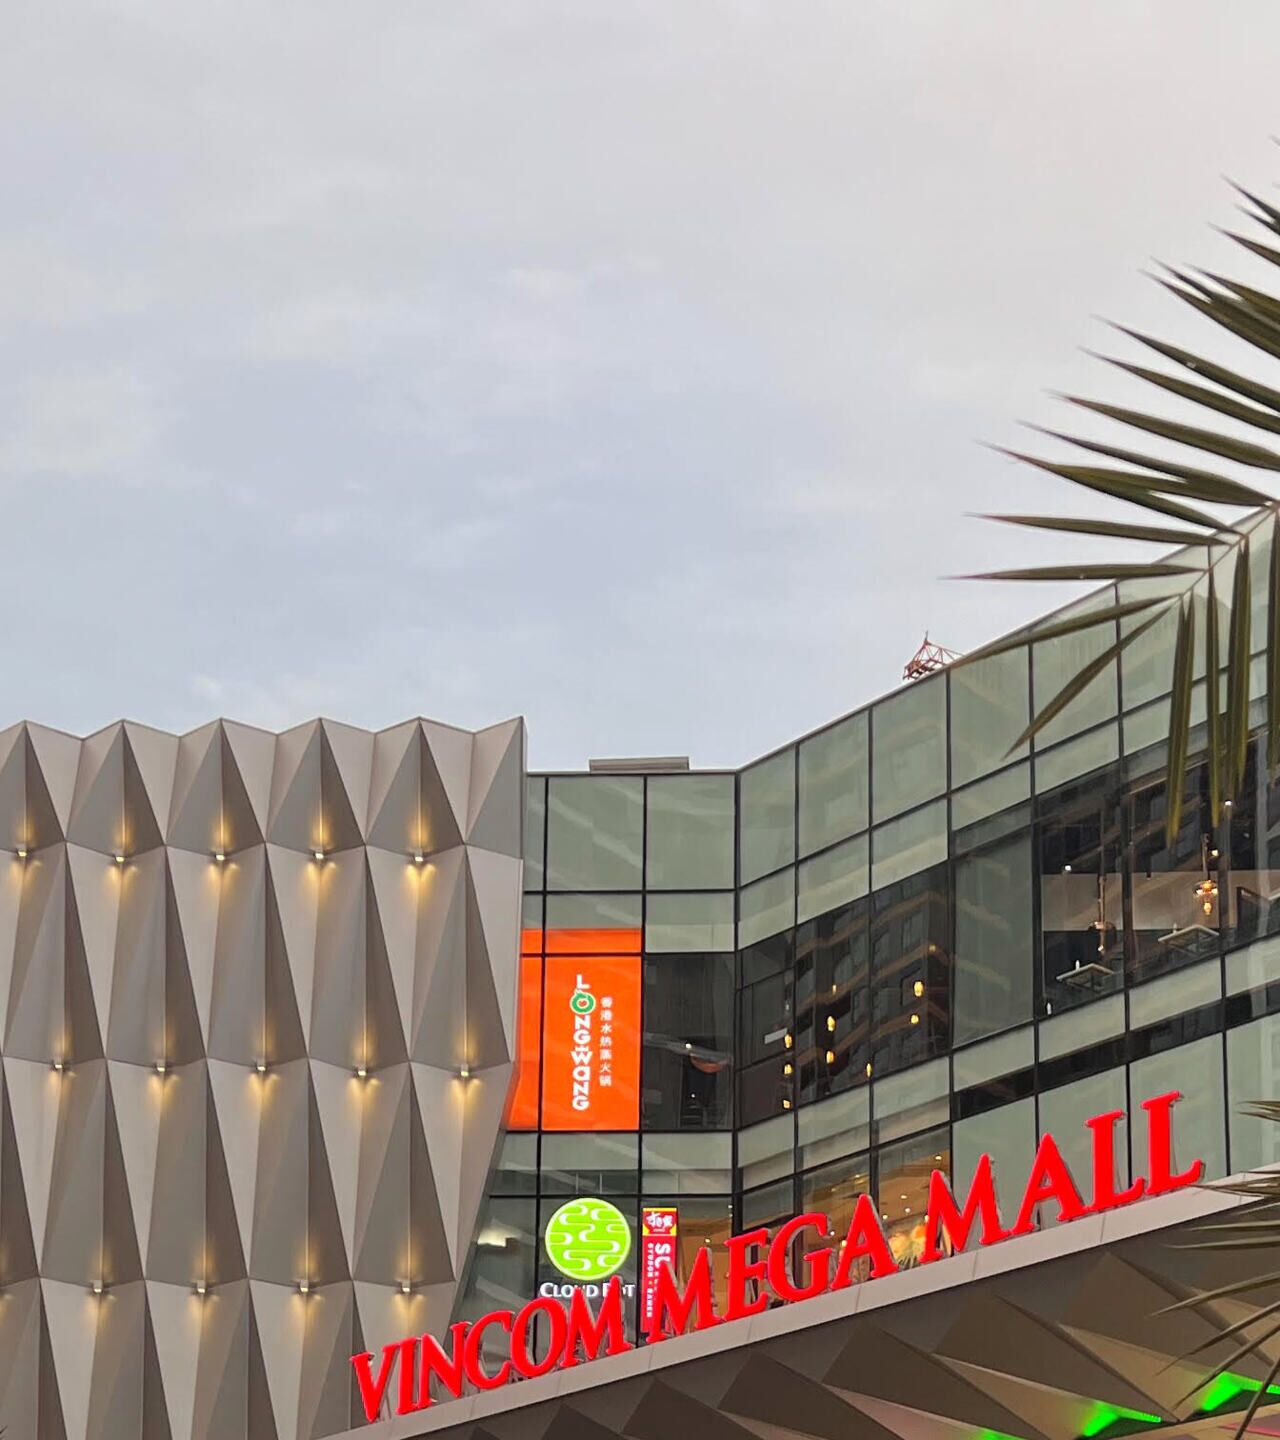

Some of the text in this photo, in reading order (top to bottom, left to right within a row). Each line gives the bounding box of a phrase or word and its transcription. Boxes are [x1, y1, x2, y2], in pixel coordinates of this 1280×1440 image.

[349, 1090, 1204, 1424] VINCOM MEGA MALL
